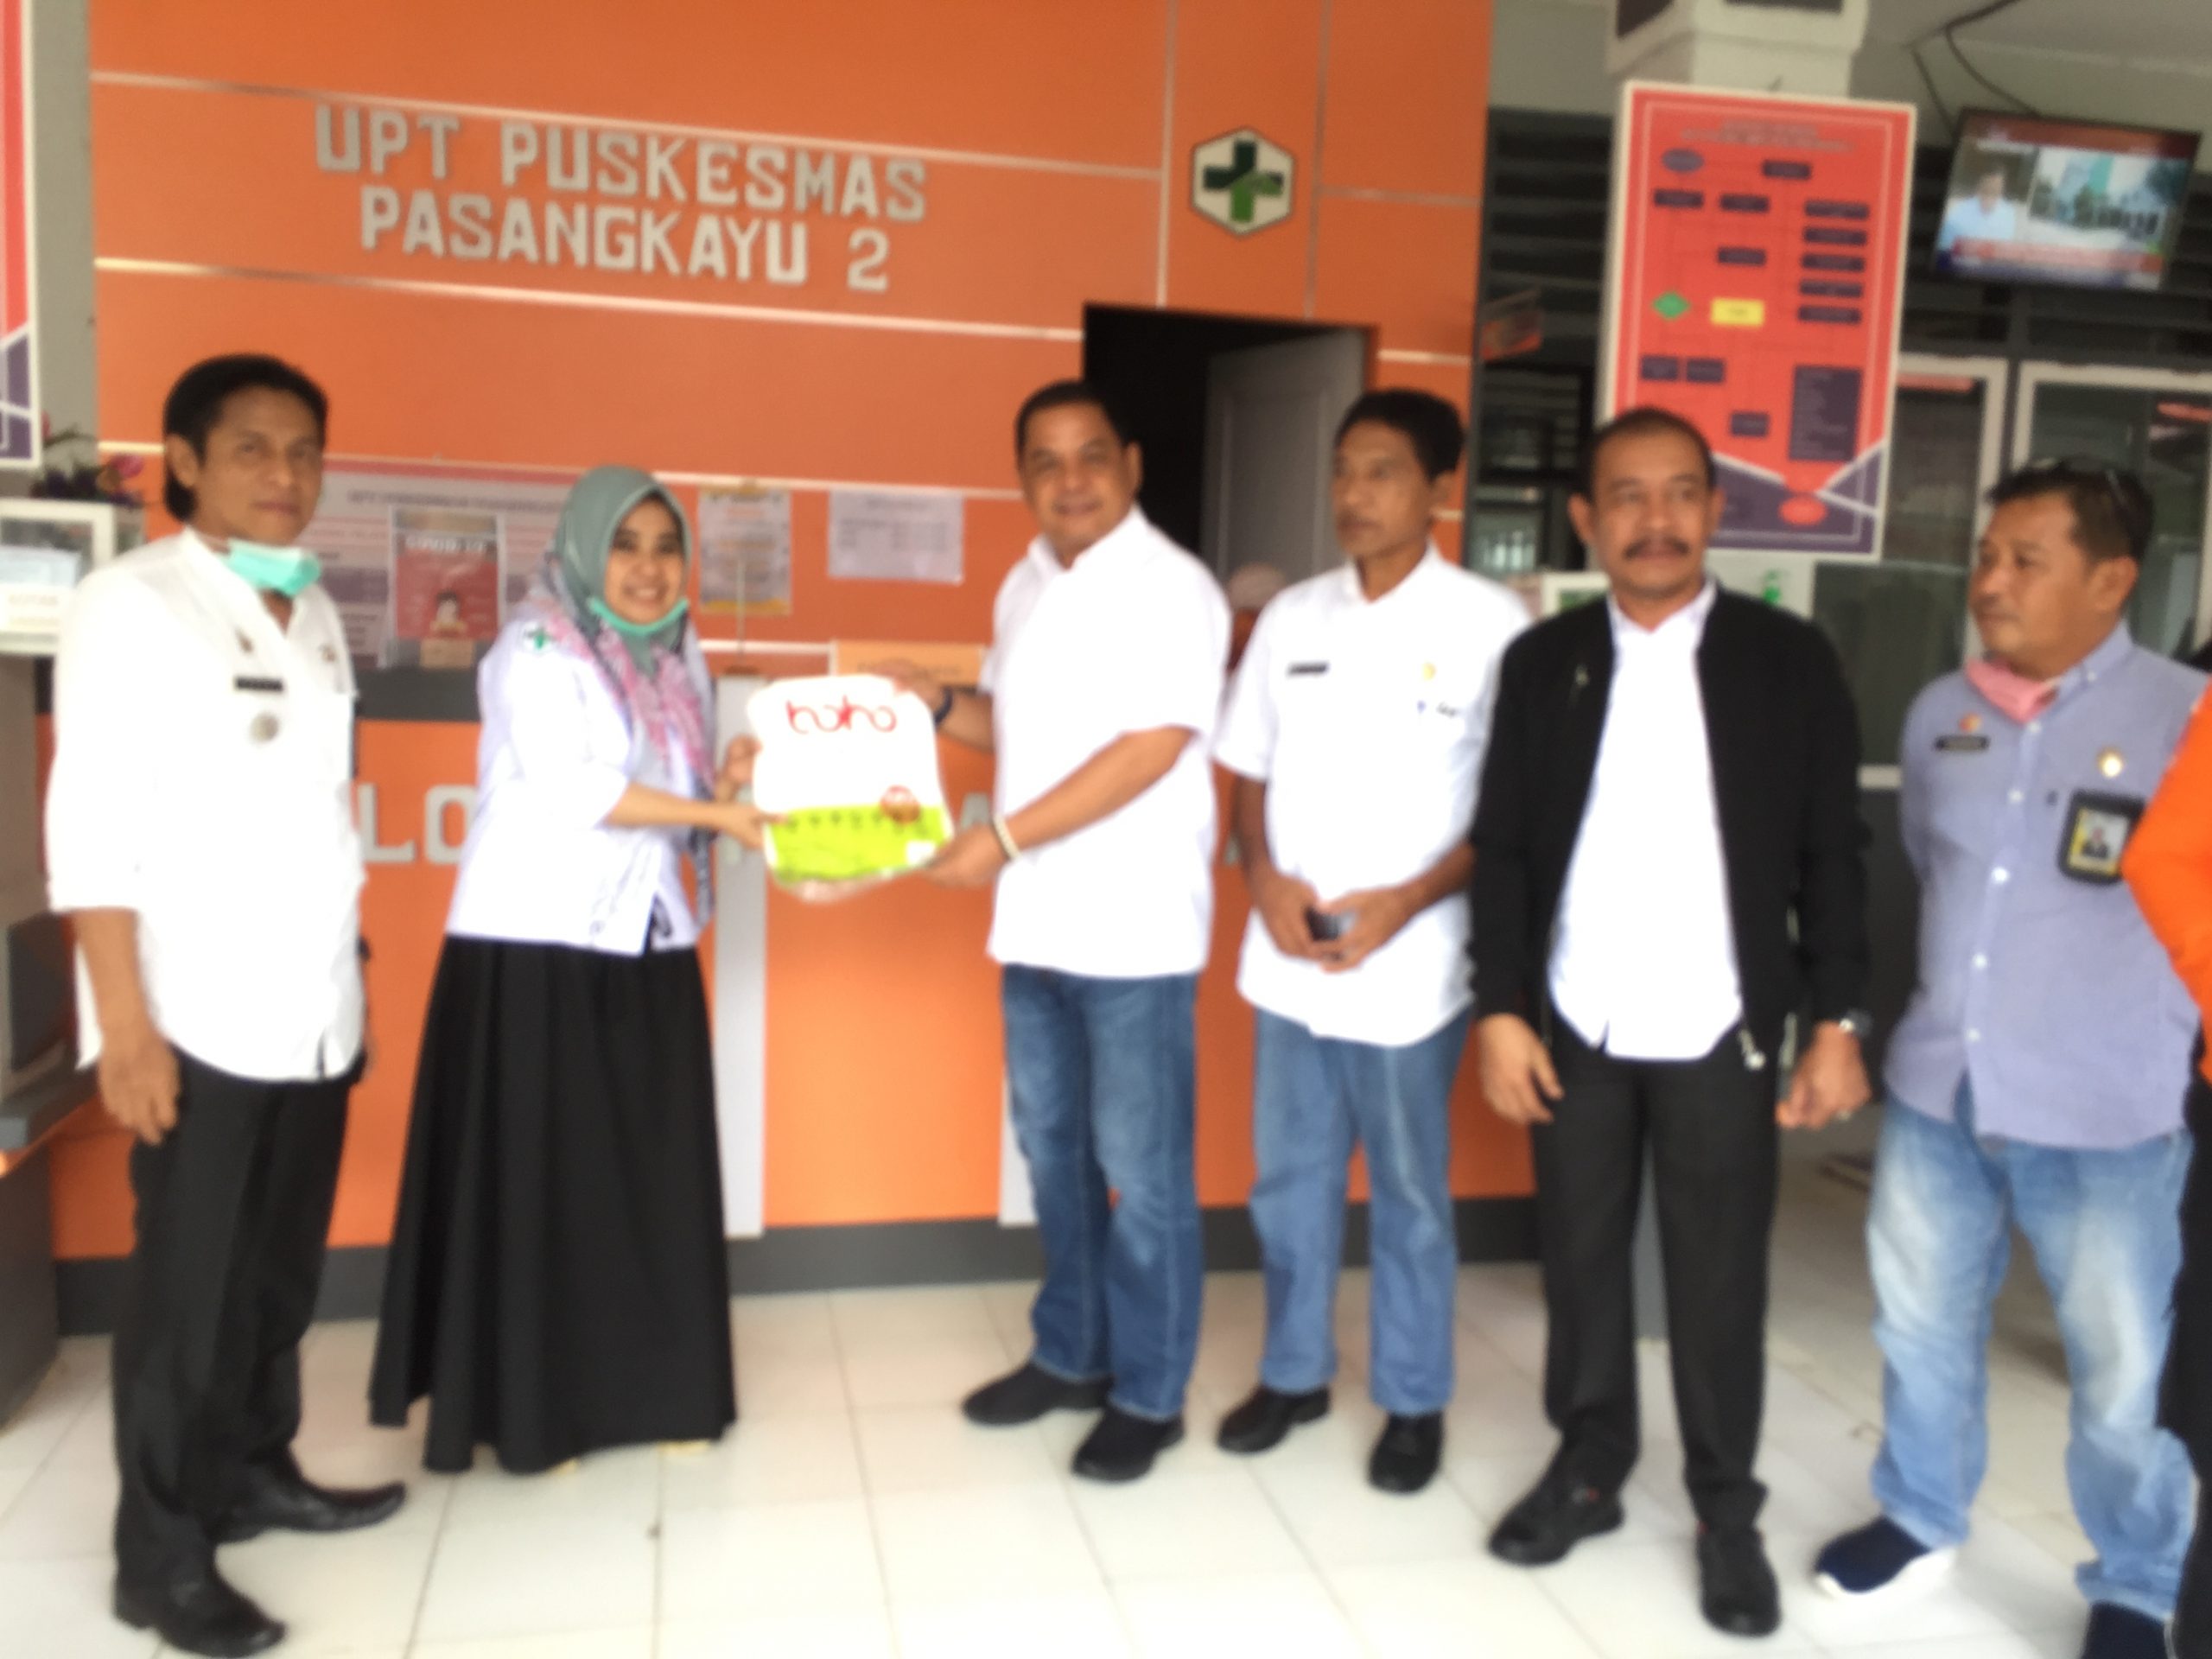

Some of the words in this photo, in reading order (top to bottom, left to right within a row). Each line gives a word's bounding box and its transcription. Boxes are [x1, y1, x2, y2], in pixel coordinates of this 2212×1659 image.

[314, 104, 461, 180] UPT
[499, 120, 927, 222] PUSKESMAS
[359, 184, 809, 285] PASANGKAYU
[845, 226, 891, 292] 2
